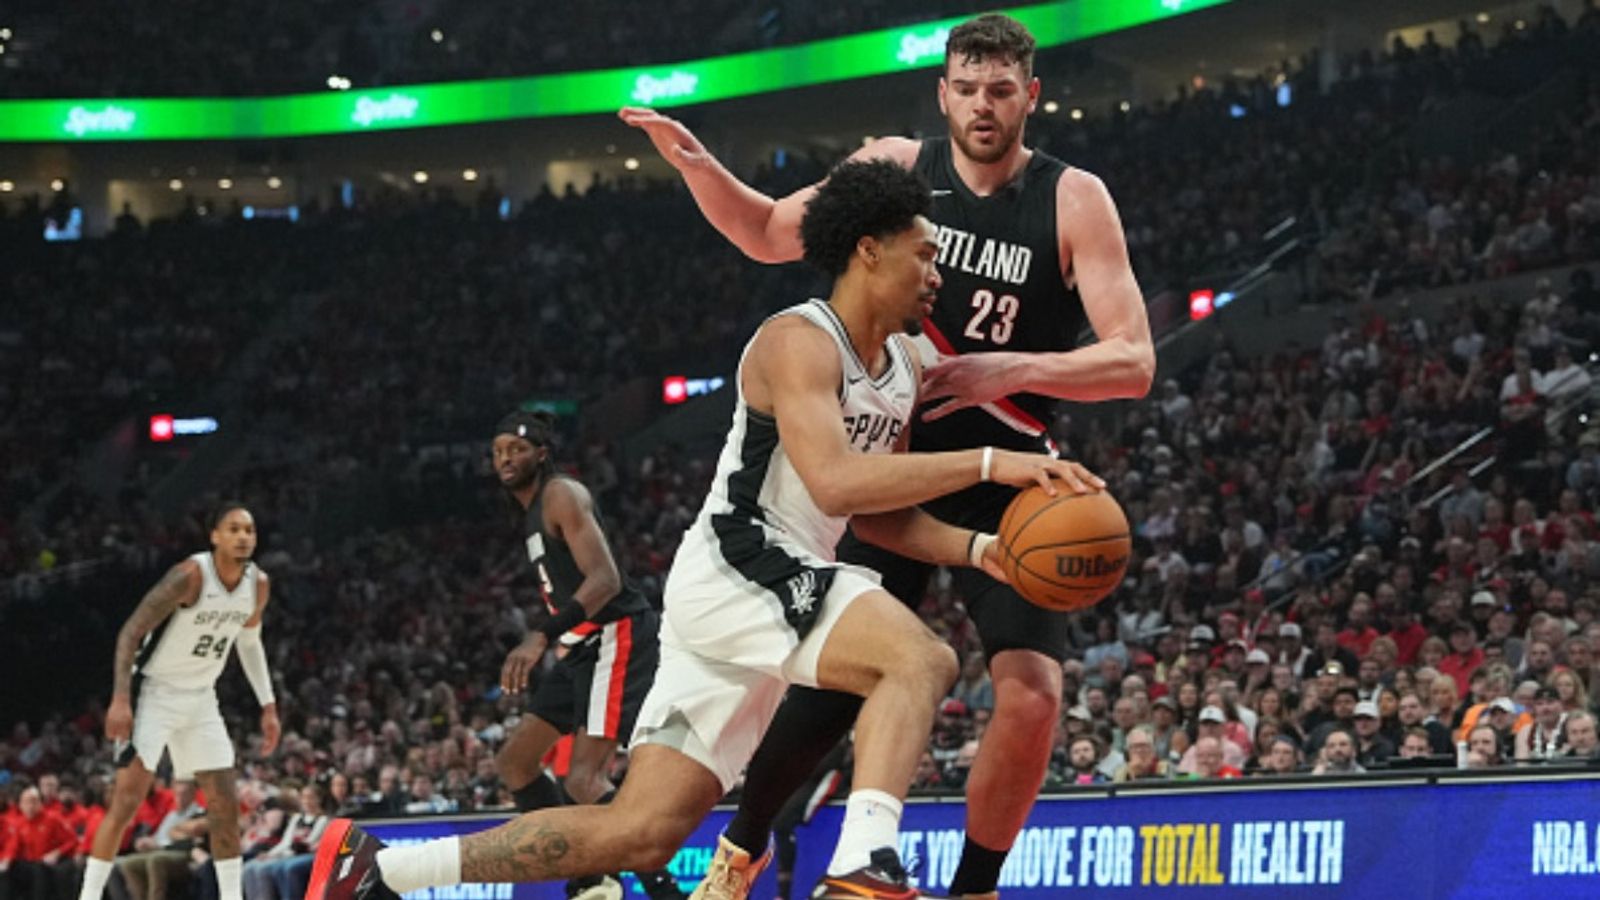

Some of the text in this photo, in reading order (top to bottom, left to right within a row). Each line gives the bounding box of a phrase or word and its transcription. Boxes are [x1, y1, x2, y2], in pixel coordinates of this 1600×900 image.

[896, 27, 950, 65] Sprit
[629, 70, 700, 106] Sprite
[932, 222, 1033, 286] RTLAND
[963, 288, 1020, 346] 23
[843, 413, 904, 453] PUR
[191, 633, 229, 660] 24
[1077, 824, 1136, 887] FOR
[1139, 822, 1226, 887] TOTAL
[1228, 819, 1345, 885] HEALTH
